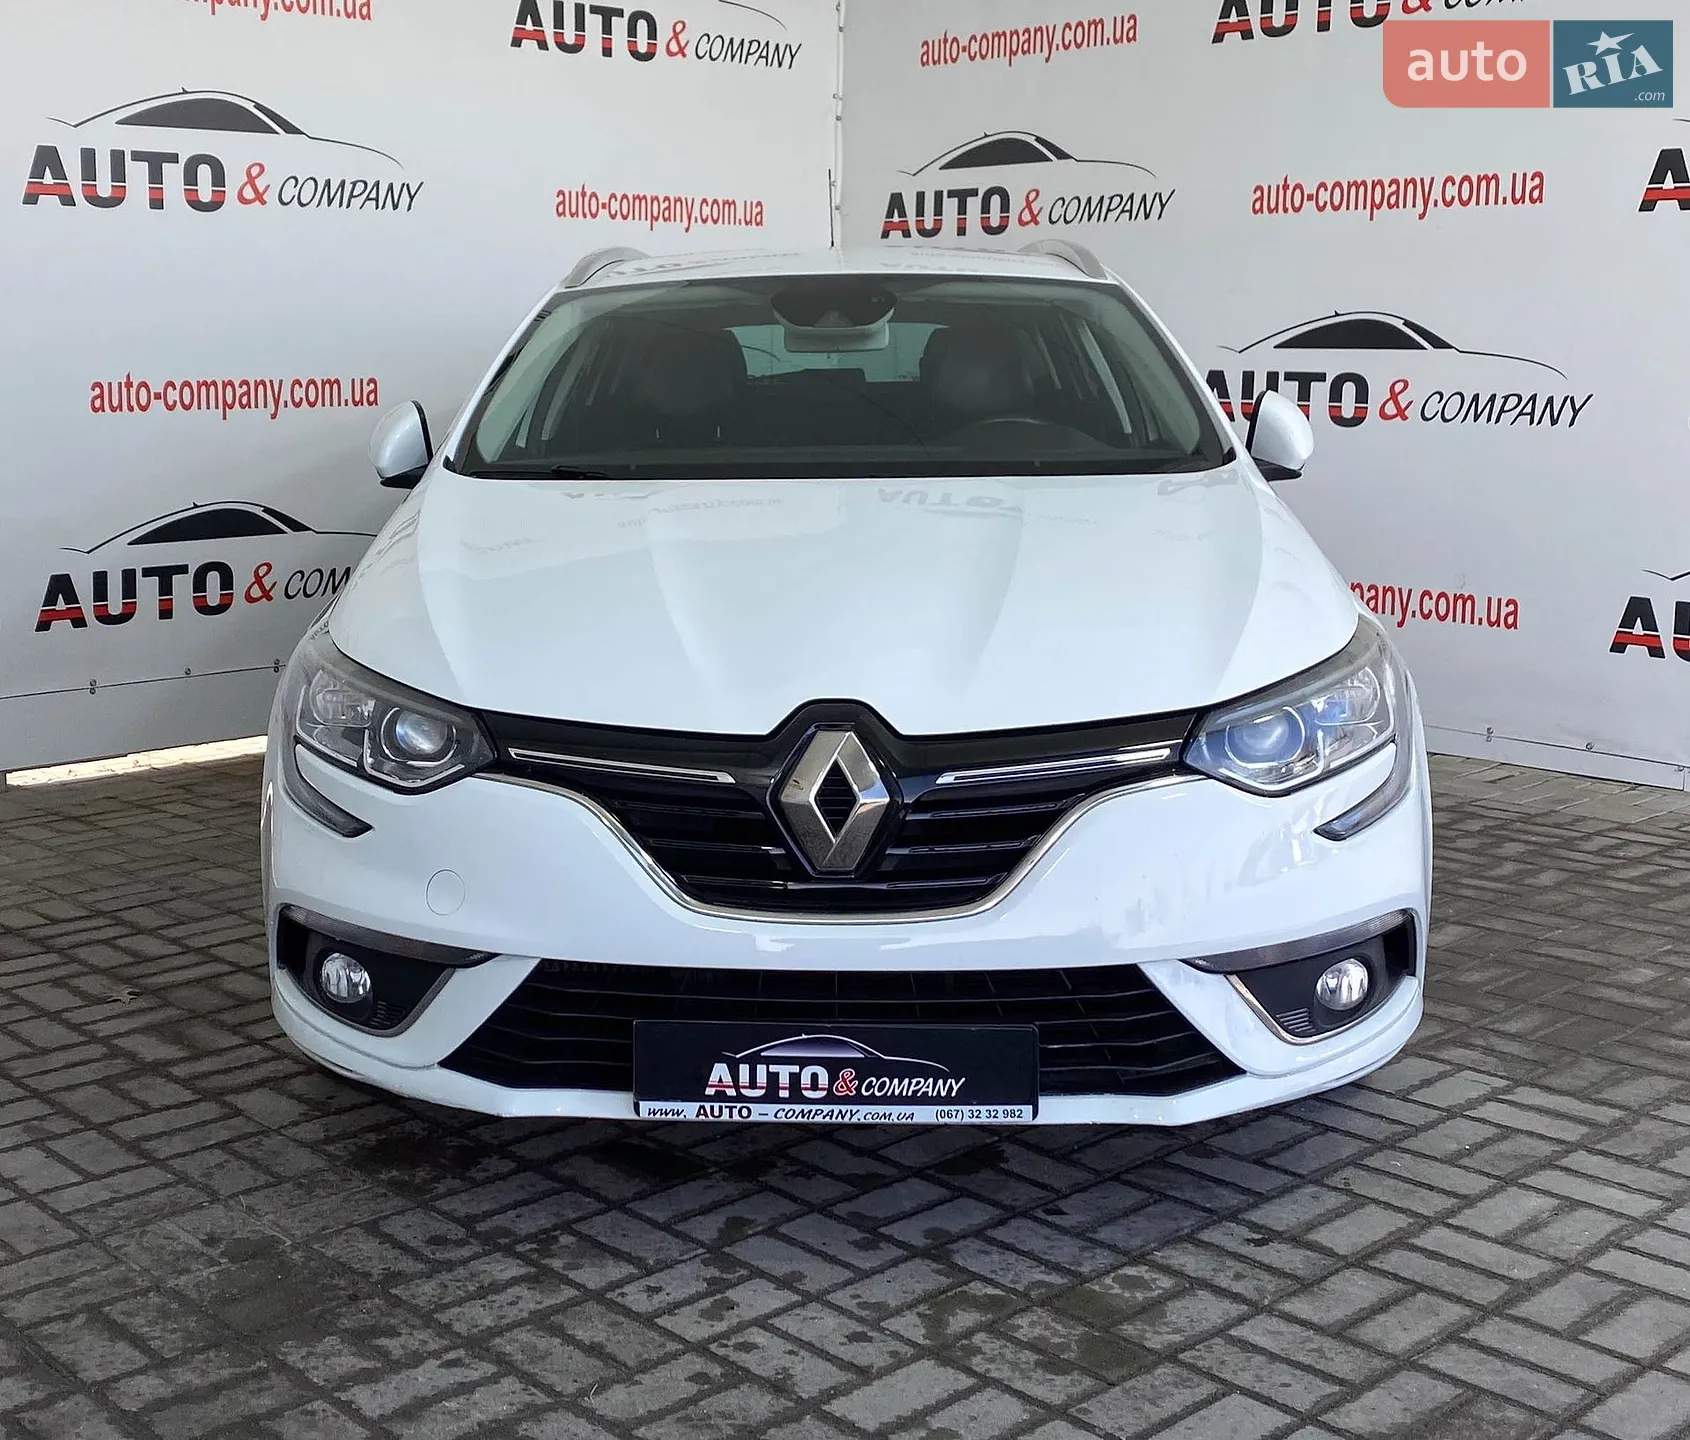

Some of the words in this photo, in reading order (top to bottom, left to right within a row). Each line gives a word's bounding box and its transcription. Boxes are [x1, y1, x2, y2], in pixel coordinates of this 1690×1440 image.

[511, 0, 657, 62] AUTO
[665, 20, 690, 58] &
[695, 33, 801, 69] COMPANY
[919, 14, 1138, 67] auto-company.com.ua
[22, 146, 225, 213] AUTO
[236, 163, 269, 206] &
[278, 178, 424, 212] COMPANY
[1251, 170, 1545, 221] auto-company.com.ua
[555, 184, 764, 231] auto-company.com.ua
[880, 186, 1011, 239] AUTO
[1017, 188, 1041, 228] &
[1048, 189, 1176, 225] COMPANY
[90, 371, 379, 420] auto-company.com.ua
[1378, 379, 1413, 422] &
[1420, 391, 1594, 428] COMPANY
[35, 561, 234, 632] AUTO
[244, 562, 278, 604] &
[704, 1063, 828, 1098] AUTO
[833, 1068, 859, 1096] &
[861, 1076, 965, 1098] COMPANY
[695, 1104, 752, 1120] AUTO
[935, 1109, 965, 1122] (067)
[967, 1108, 982, 1120] 32
[985, 1108, 999, 1120] 32
[1002, 1108, 1024, 1120] 982
